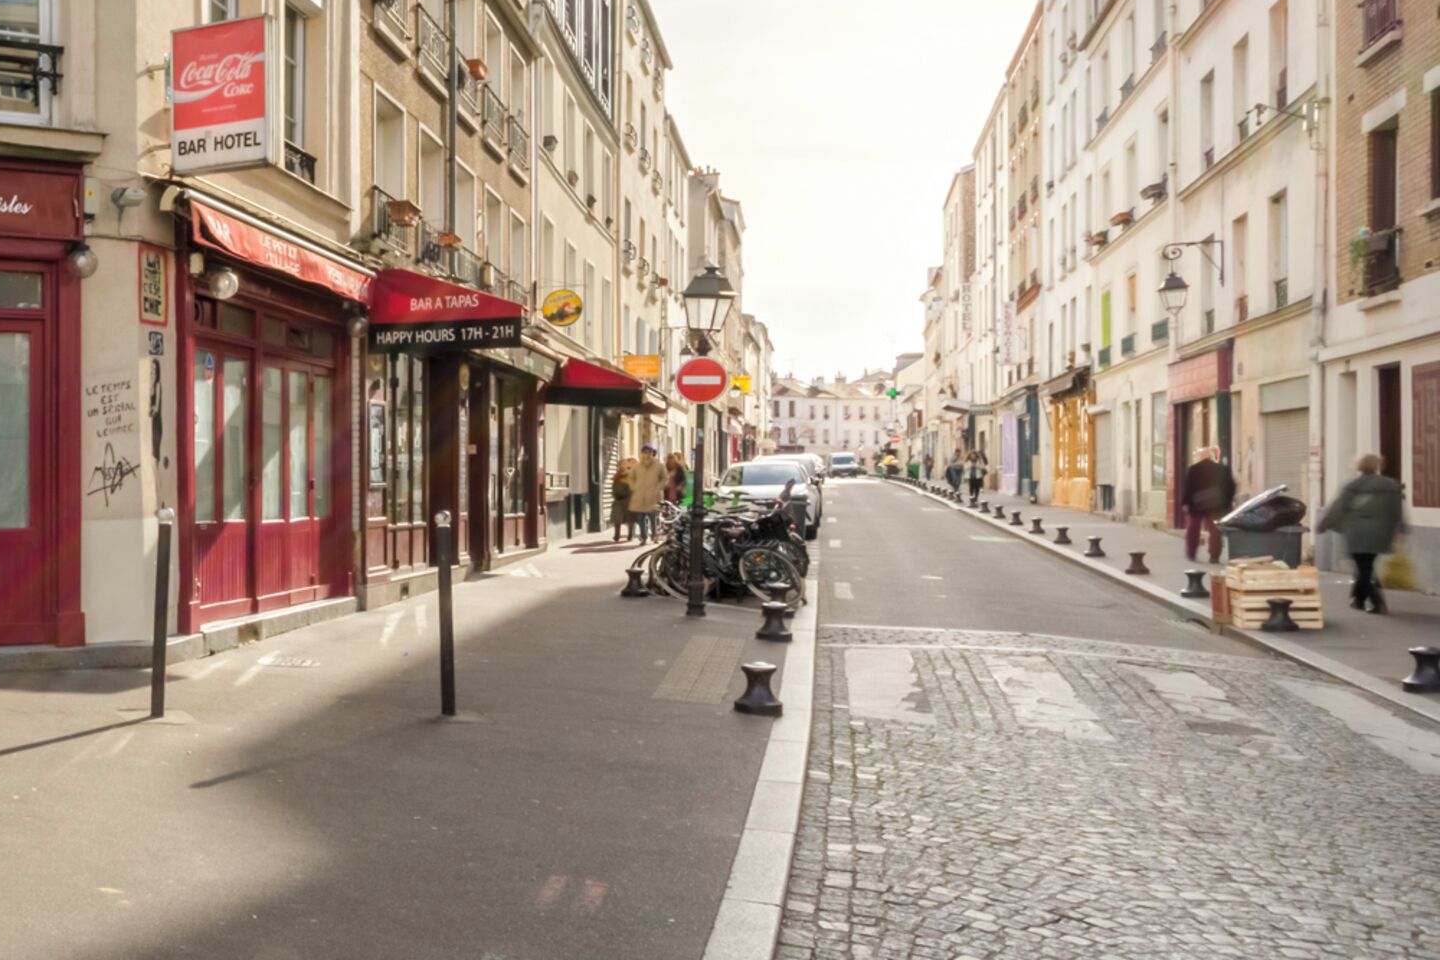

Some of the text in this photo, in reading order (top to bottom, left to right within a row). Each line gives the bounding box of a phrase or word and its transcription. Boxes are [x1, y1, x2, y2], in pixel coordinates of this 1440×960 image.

[178, 131, 262, 157] BAR HOTEL
[411, 294, 479, 311] BAR A TAPAS
[377, 331, 413, 344] HAPPY
[416, 329, 455, 343] HOURS
[461, 327, 483, 340] 17H
[492, 325, 515, 339] 21H
[86, 380, 131, 396] LE TEMPS
[100, 393, 119, 405] EST
